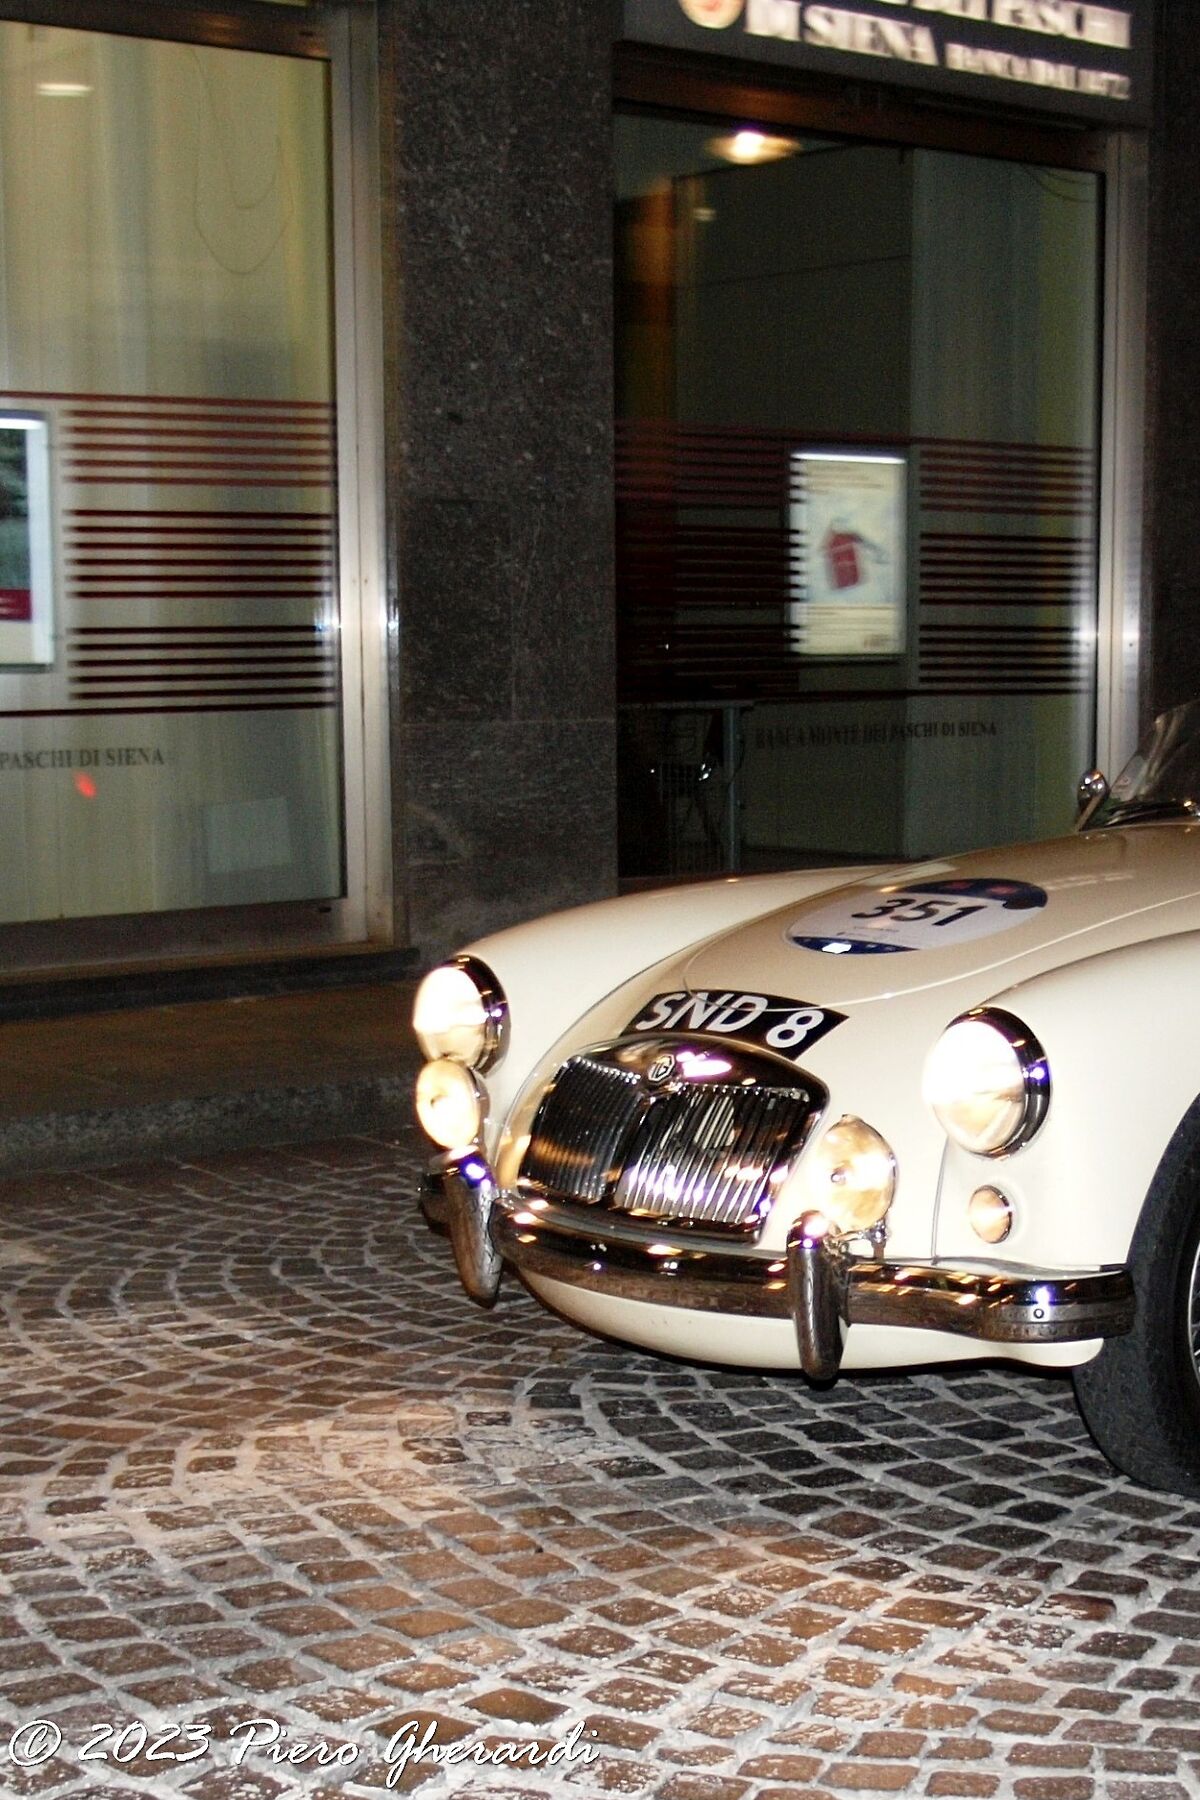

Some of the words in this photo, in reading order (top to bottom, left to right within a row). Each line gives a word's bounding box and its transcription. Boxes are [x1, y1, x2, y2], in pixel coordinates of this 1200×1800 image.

[804, 5, 938, 65] SIENA
[0, 750, 72, 770] PASCHI
[79, 749, 99, 767] DI
[105, 747, 165, 767] SIENA
[852, 897, 987, 926] 351
[636, 992, 768, 1033] SND
[766, 1010, 825, 1049] 8
